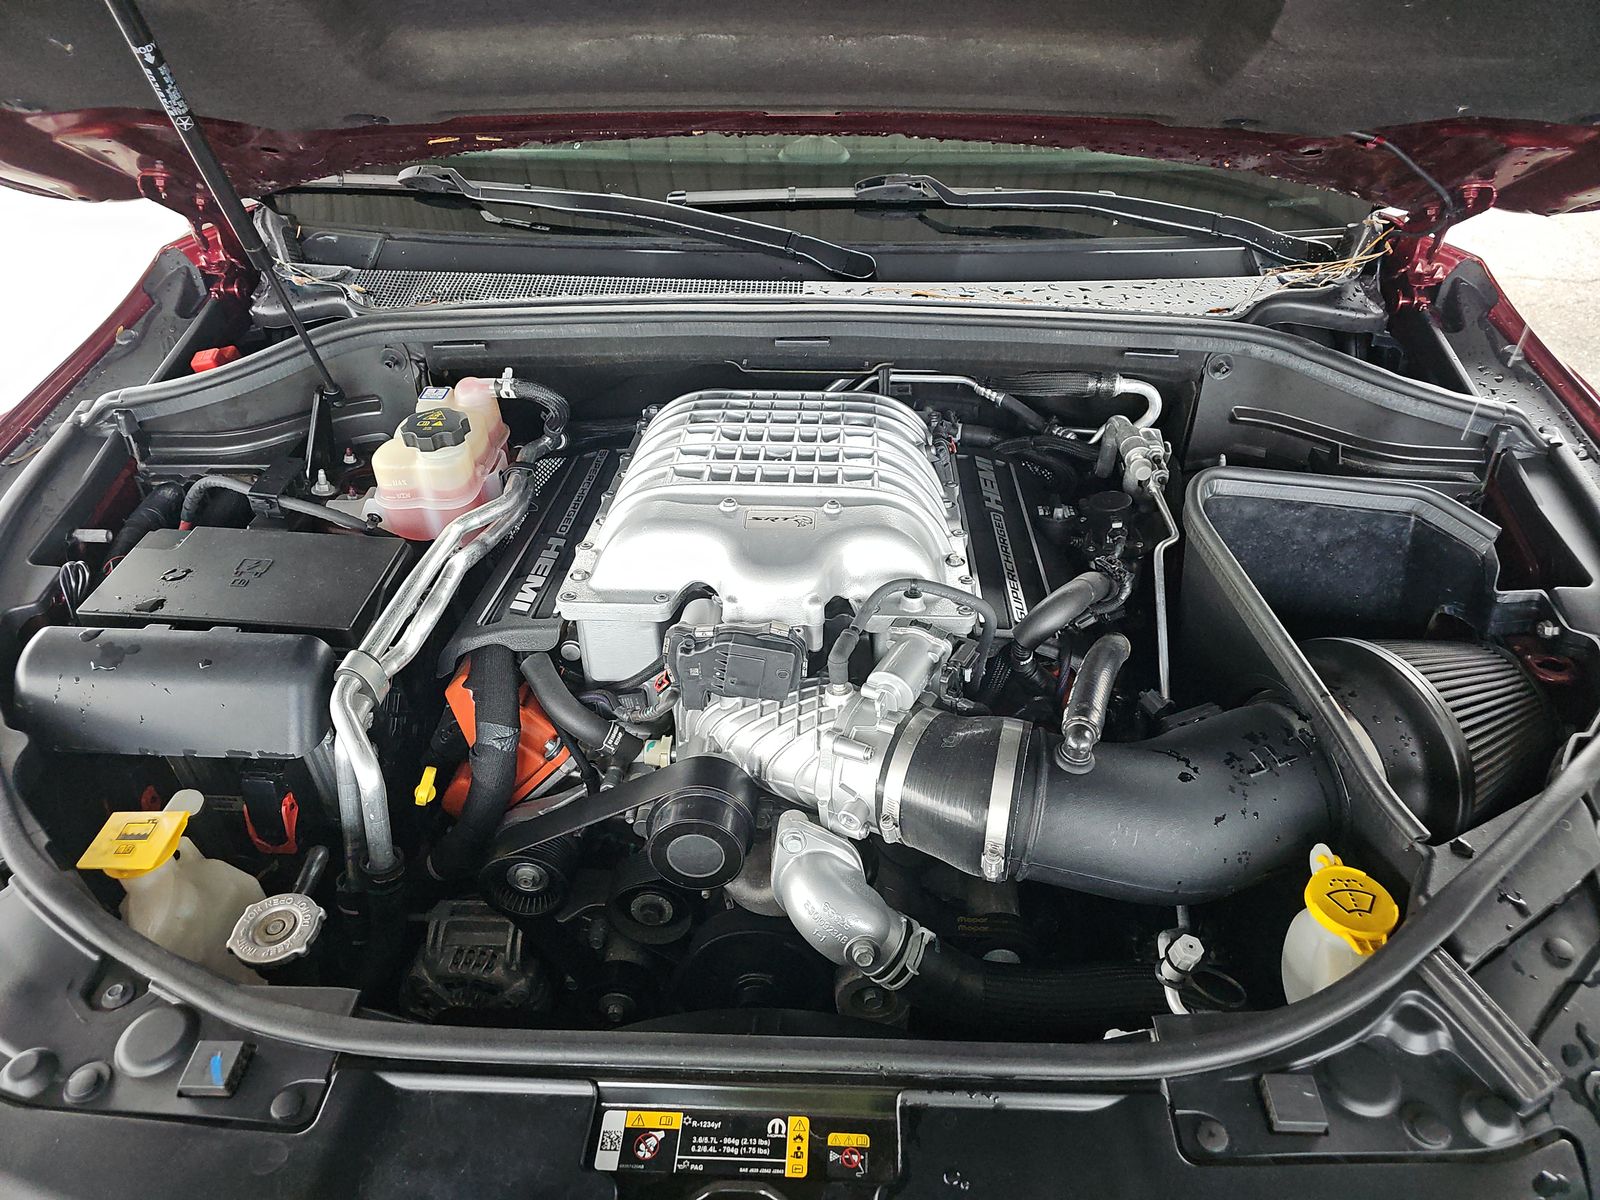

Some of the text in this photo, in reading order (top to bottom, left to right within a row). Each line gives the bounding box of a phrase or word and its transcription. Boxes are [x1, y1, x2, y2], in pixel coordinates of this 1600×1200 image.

[510, 451, 608, 614] SUPERCHARGED HEMI
[975, 455, 1027, 620] SUPERCHARGED HEMI
[265, 897, 294, 909] OPEN
[692, 1120, 721, 1130] R-1234yf
[741, 1138, 757, 1146] (2.13
[758, 1138, 770, 1147] lbs)
[757, 1147, 770, 1156] lbs)
